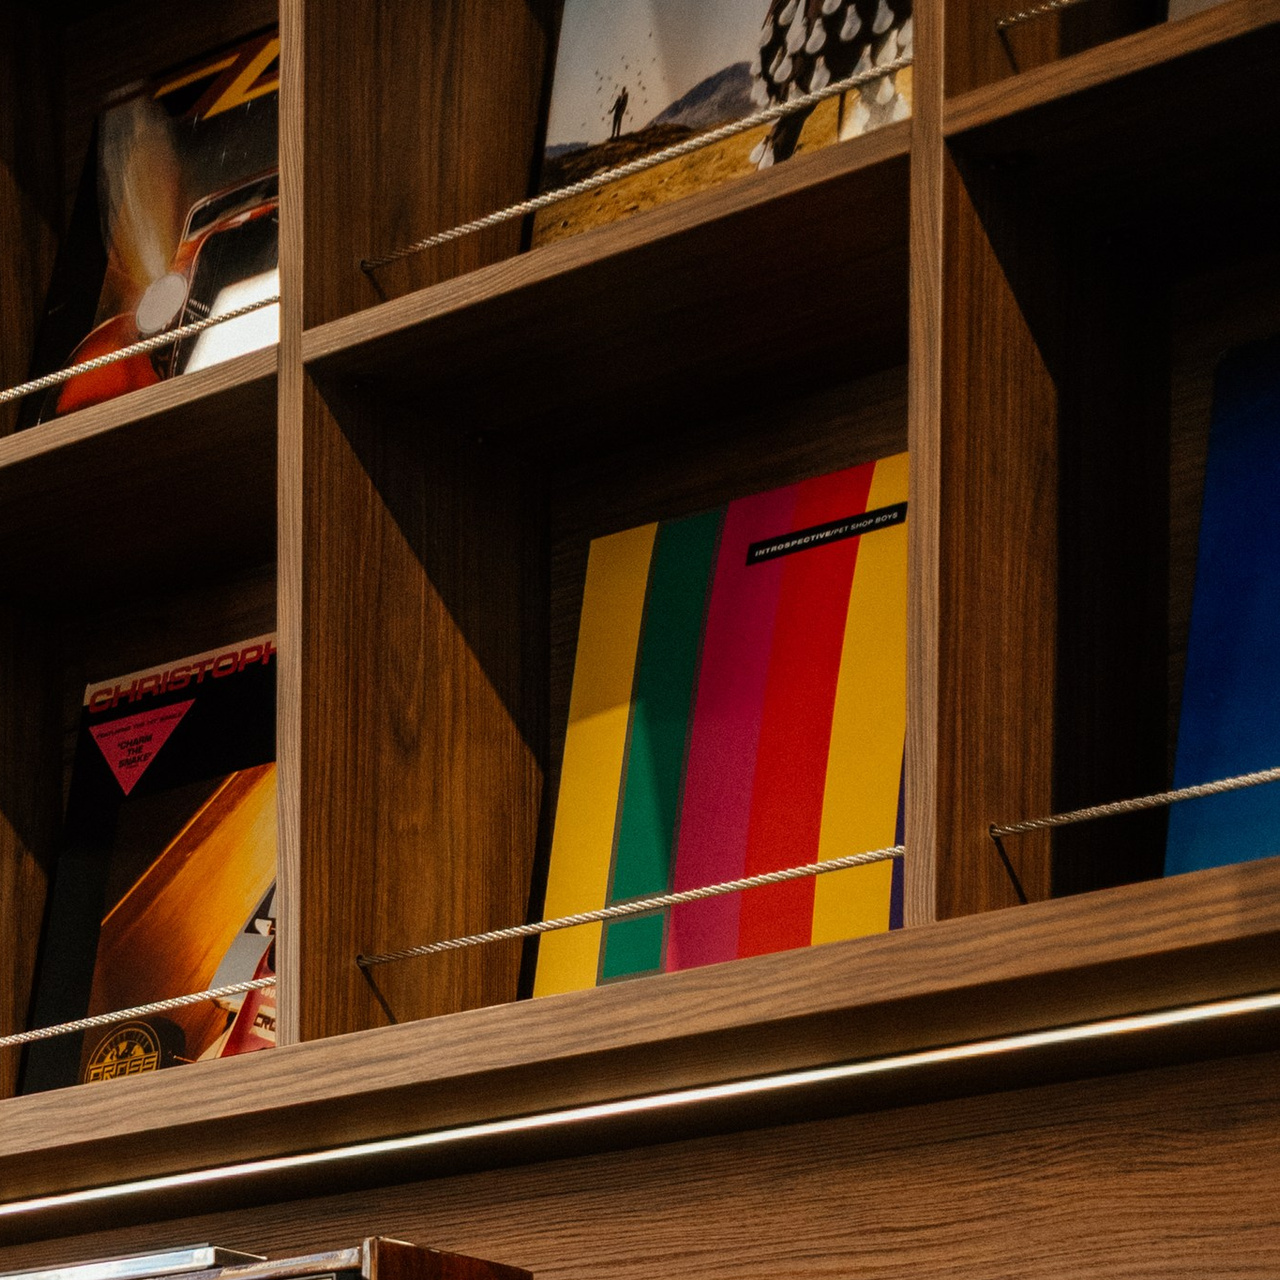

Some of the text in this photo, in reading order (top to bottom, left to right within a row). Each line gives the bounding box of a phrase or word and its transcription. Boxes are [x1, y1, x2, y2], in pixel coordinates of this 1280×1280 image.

[850, 518, 874, 531] SHOP
[875, 511, 898, 524] BOYS
[126, 745, 143, 756] THE
